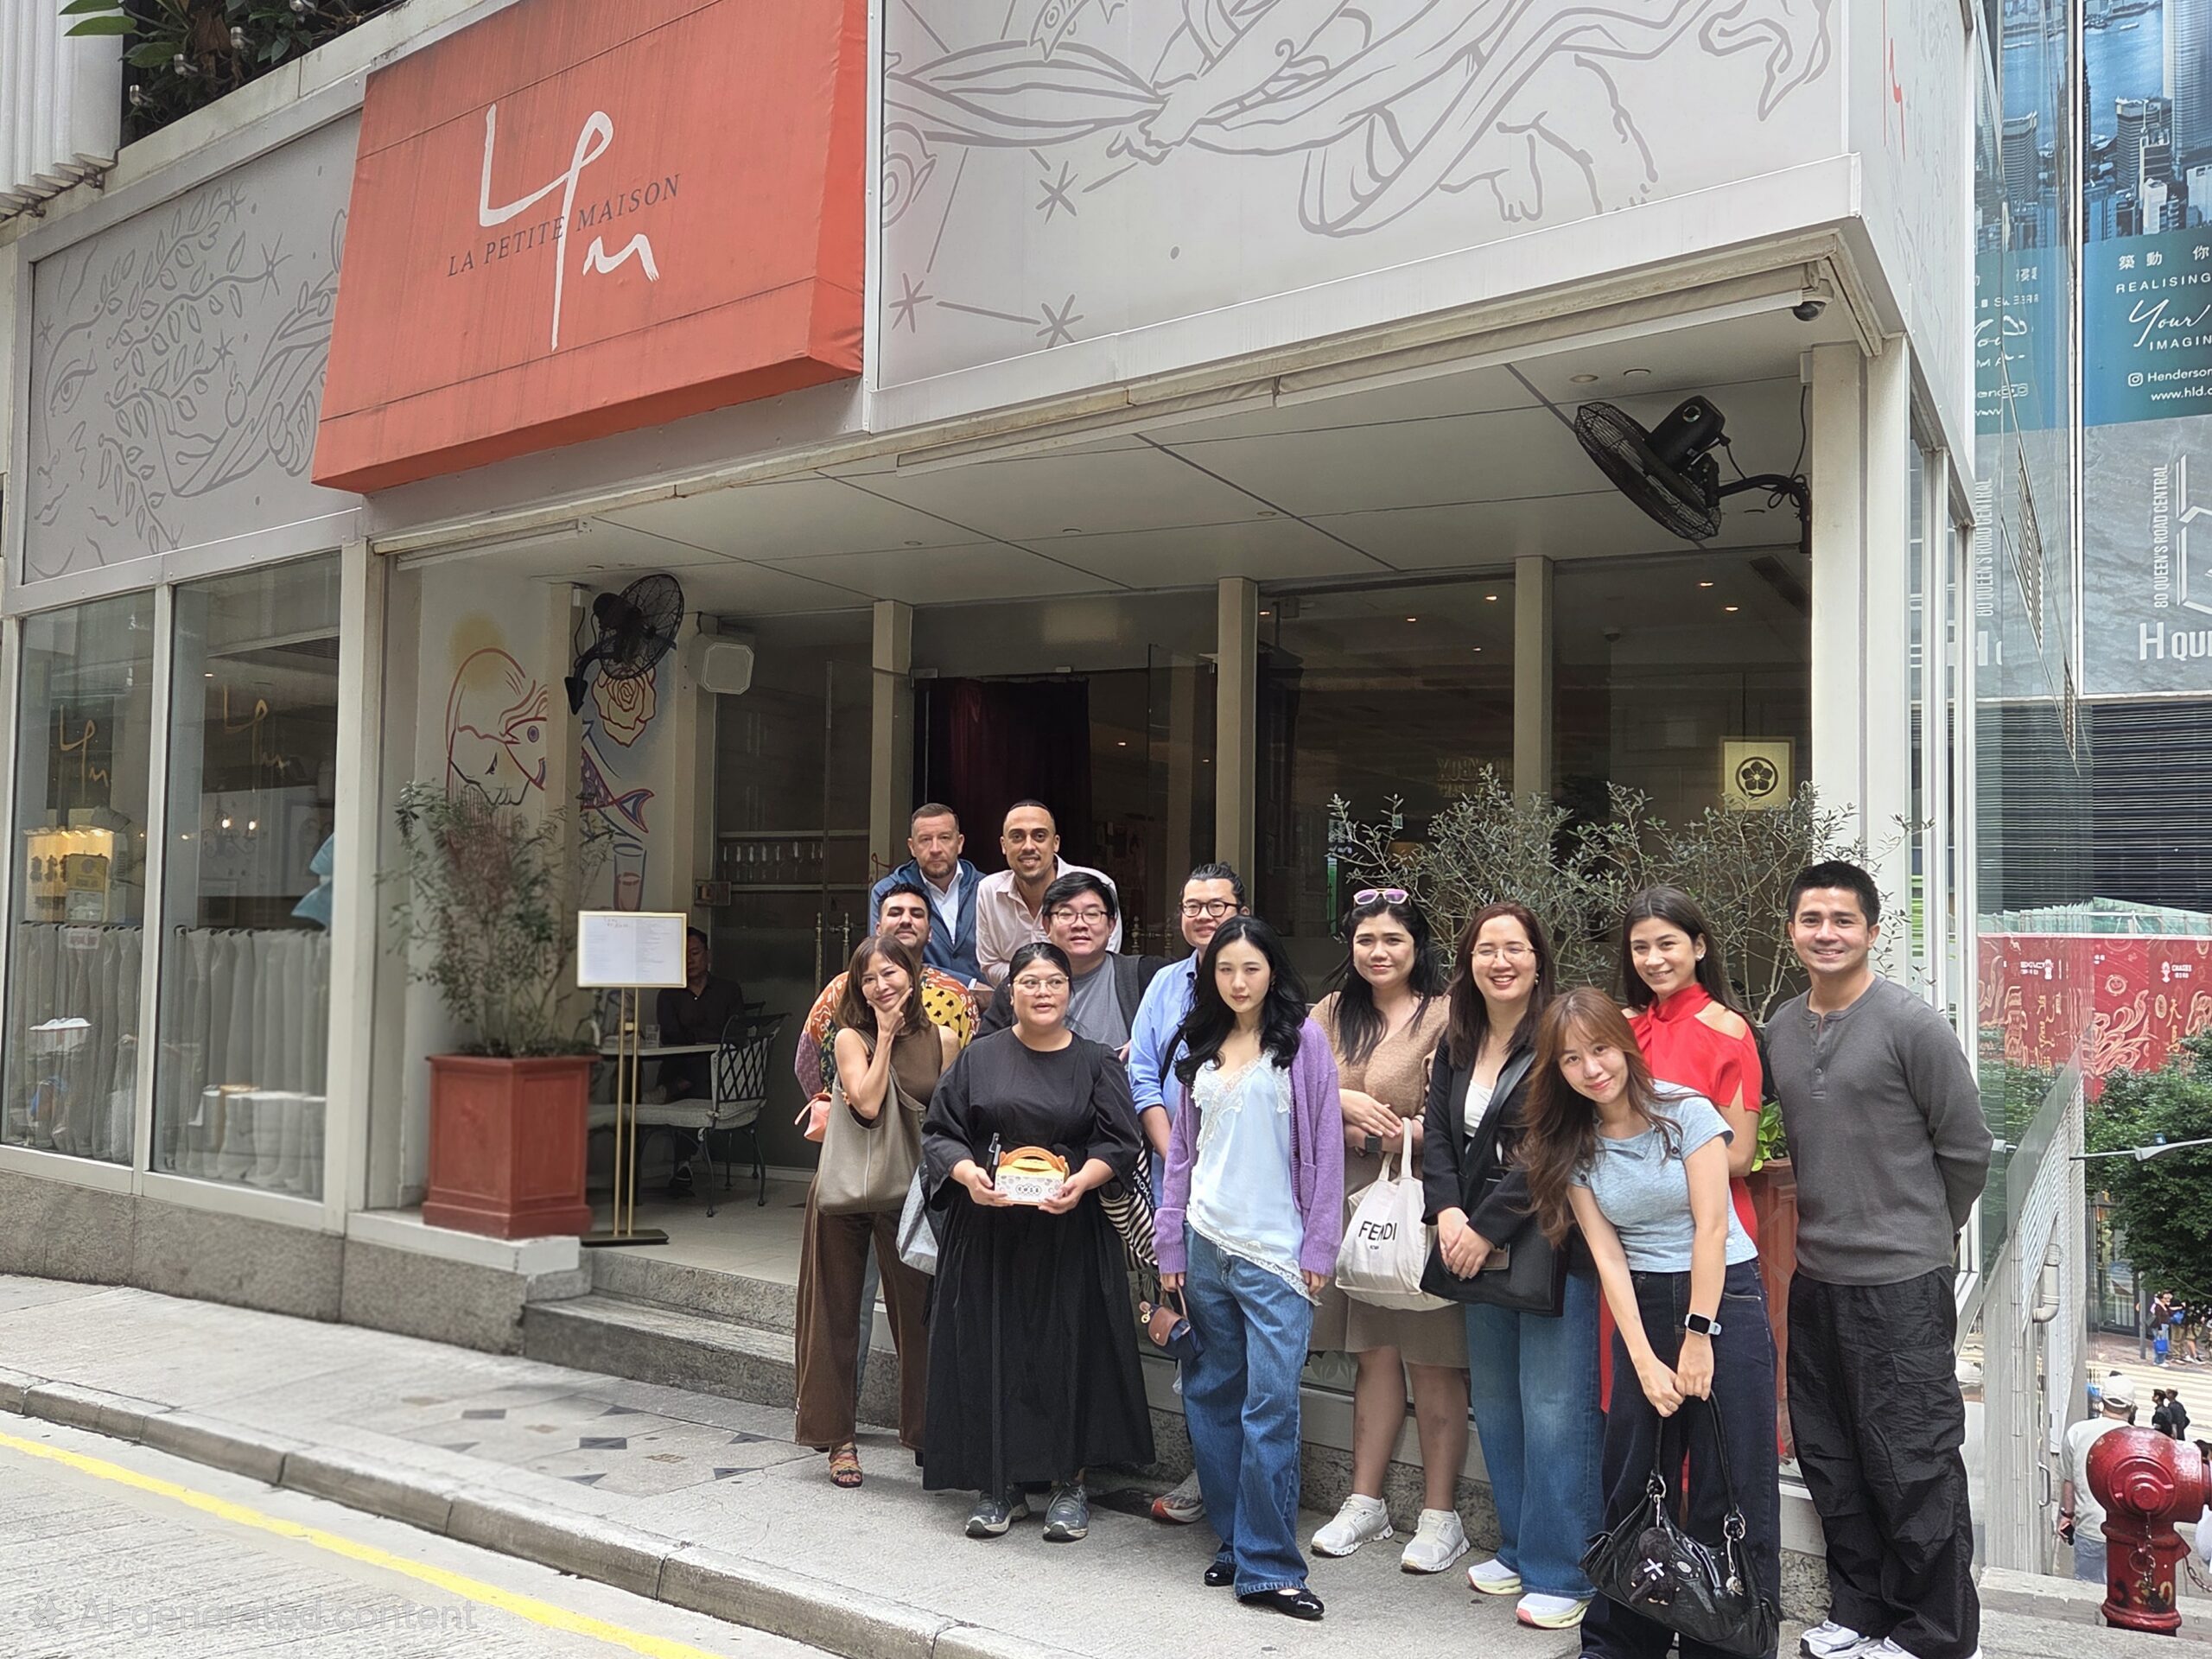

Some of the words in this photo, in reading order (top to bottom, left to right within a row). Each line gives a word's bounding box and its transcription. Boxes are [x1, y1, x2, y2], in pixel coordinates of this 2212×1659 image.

[447, 250, 474, 277] LA
[483, 216, 565, 264] PETITE
[576, 174, 680, 232] MAISON
[2116, 272, 2212, 295] REALISING
[2128, 298, 2212, 347] Your
[2149, 334, 2212, 352] IMAGIN
[2153, 464, 2169, 512] CENTRAL
[2153, 514, 2169, 544] ROAD
[2153, 546, 2169, 591] QUEEN'S
[2154, 594, 2169, 608] 80
[2139, 621, 2164, 661] H
